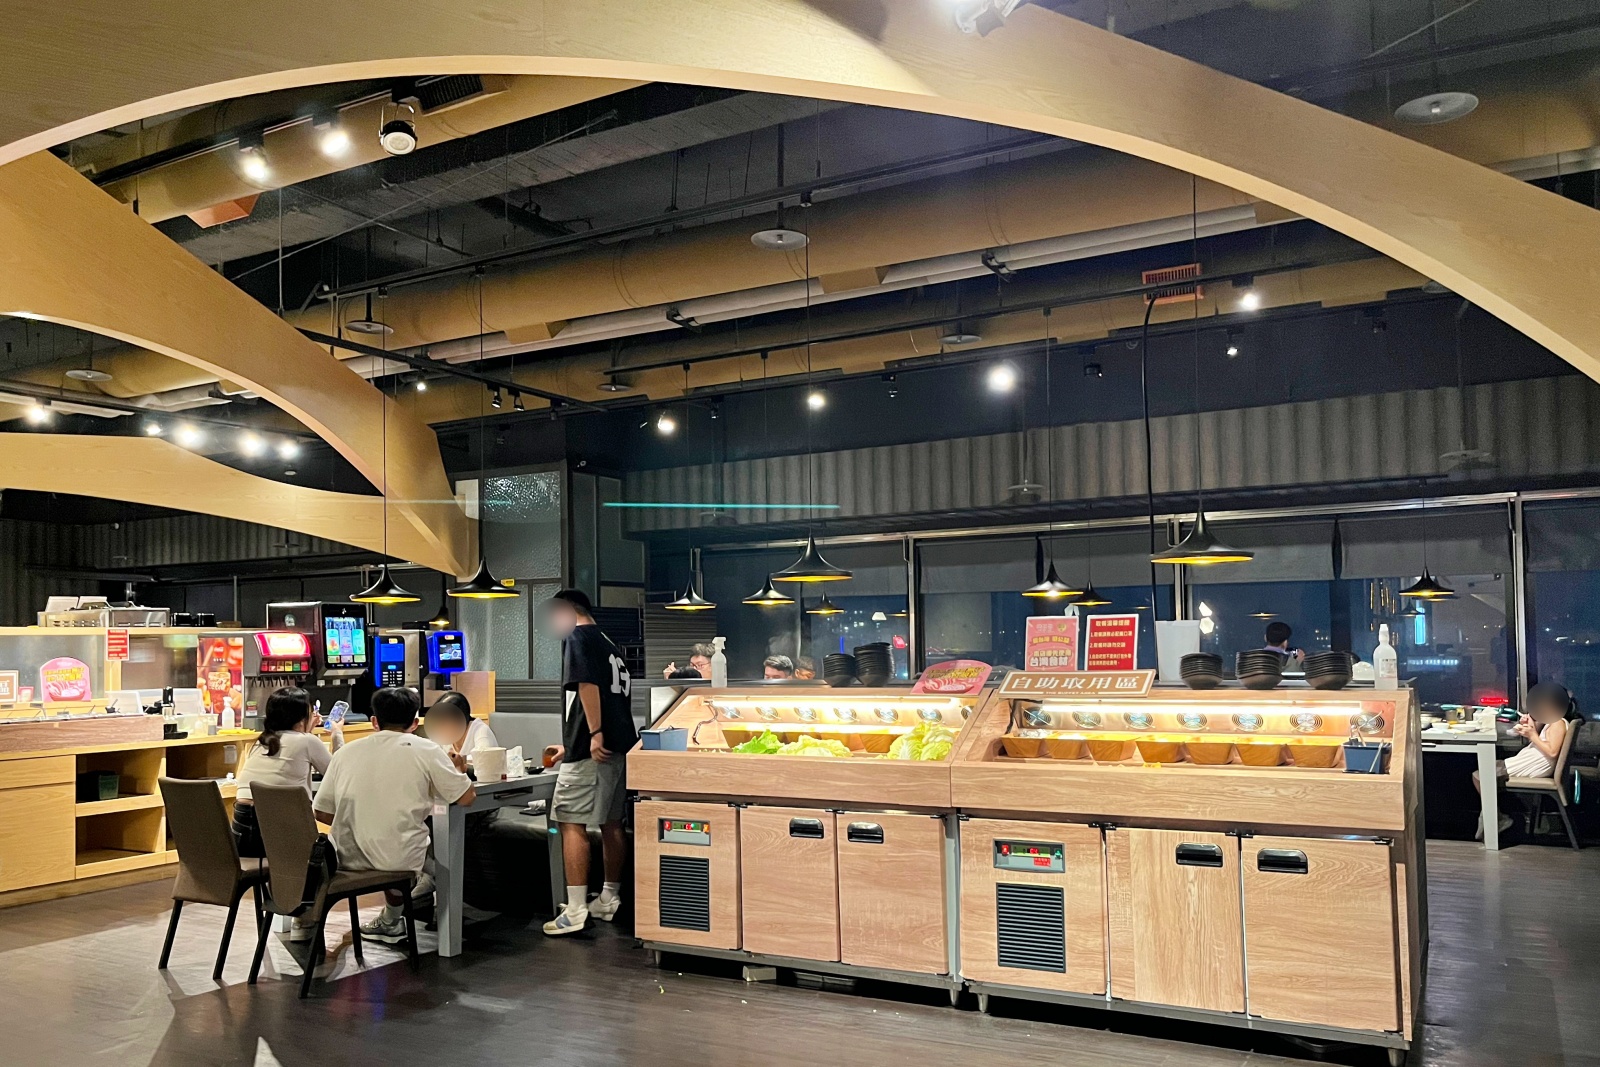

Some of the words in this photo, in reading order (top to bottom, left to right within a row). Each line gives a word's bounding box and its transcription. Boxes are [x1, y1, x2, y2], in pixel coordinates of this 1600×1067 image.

[1011, 676, 1140, 689] 自助取用區
